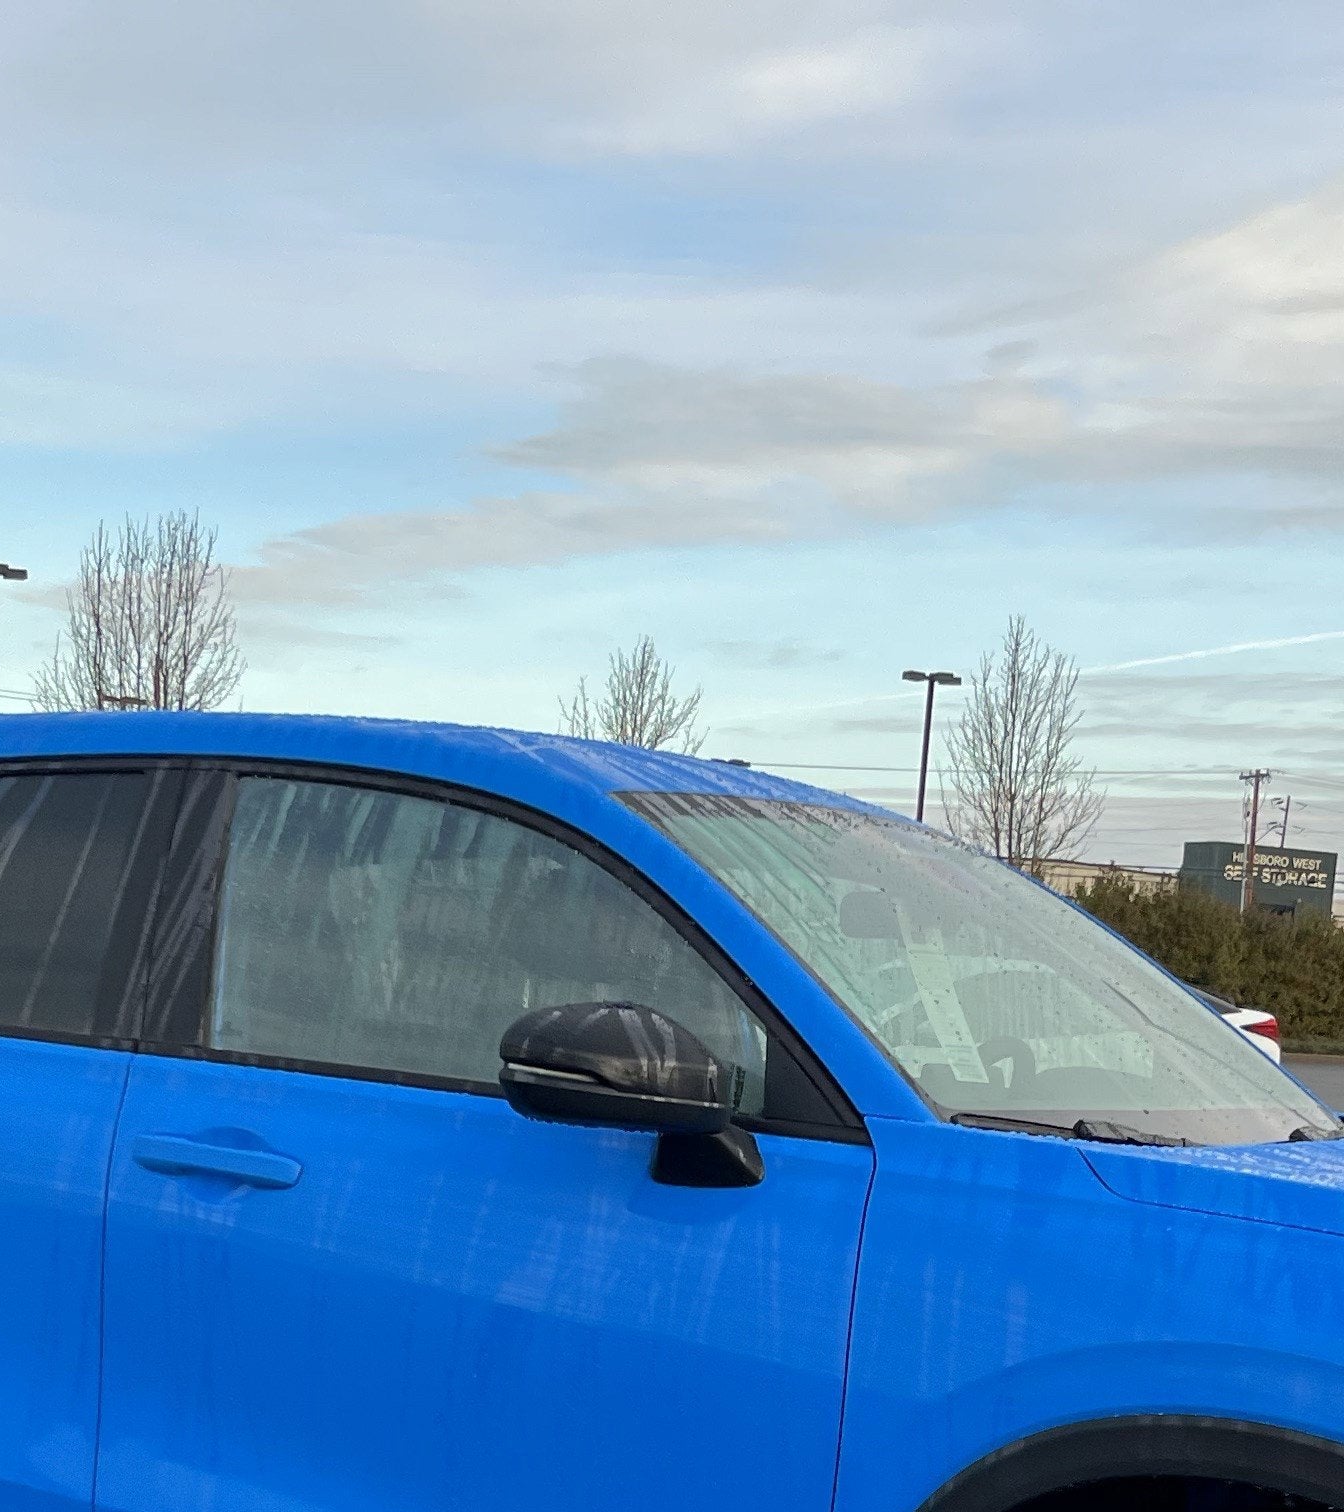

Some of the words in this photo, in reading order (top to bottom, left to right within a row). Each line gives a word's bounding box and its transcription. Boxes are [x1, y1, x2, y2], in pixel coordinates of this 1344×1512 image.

[1232, 851, 1289, 868] HISBORO
[1292, 857, 1322, 870] WEST
[1224, 864, 1259, 881] SEF
[1261, 867, 1328, 889] STORAGE
